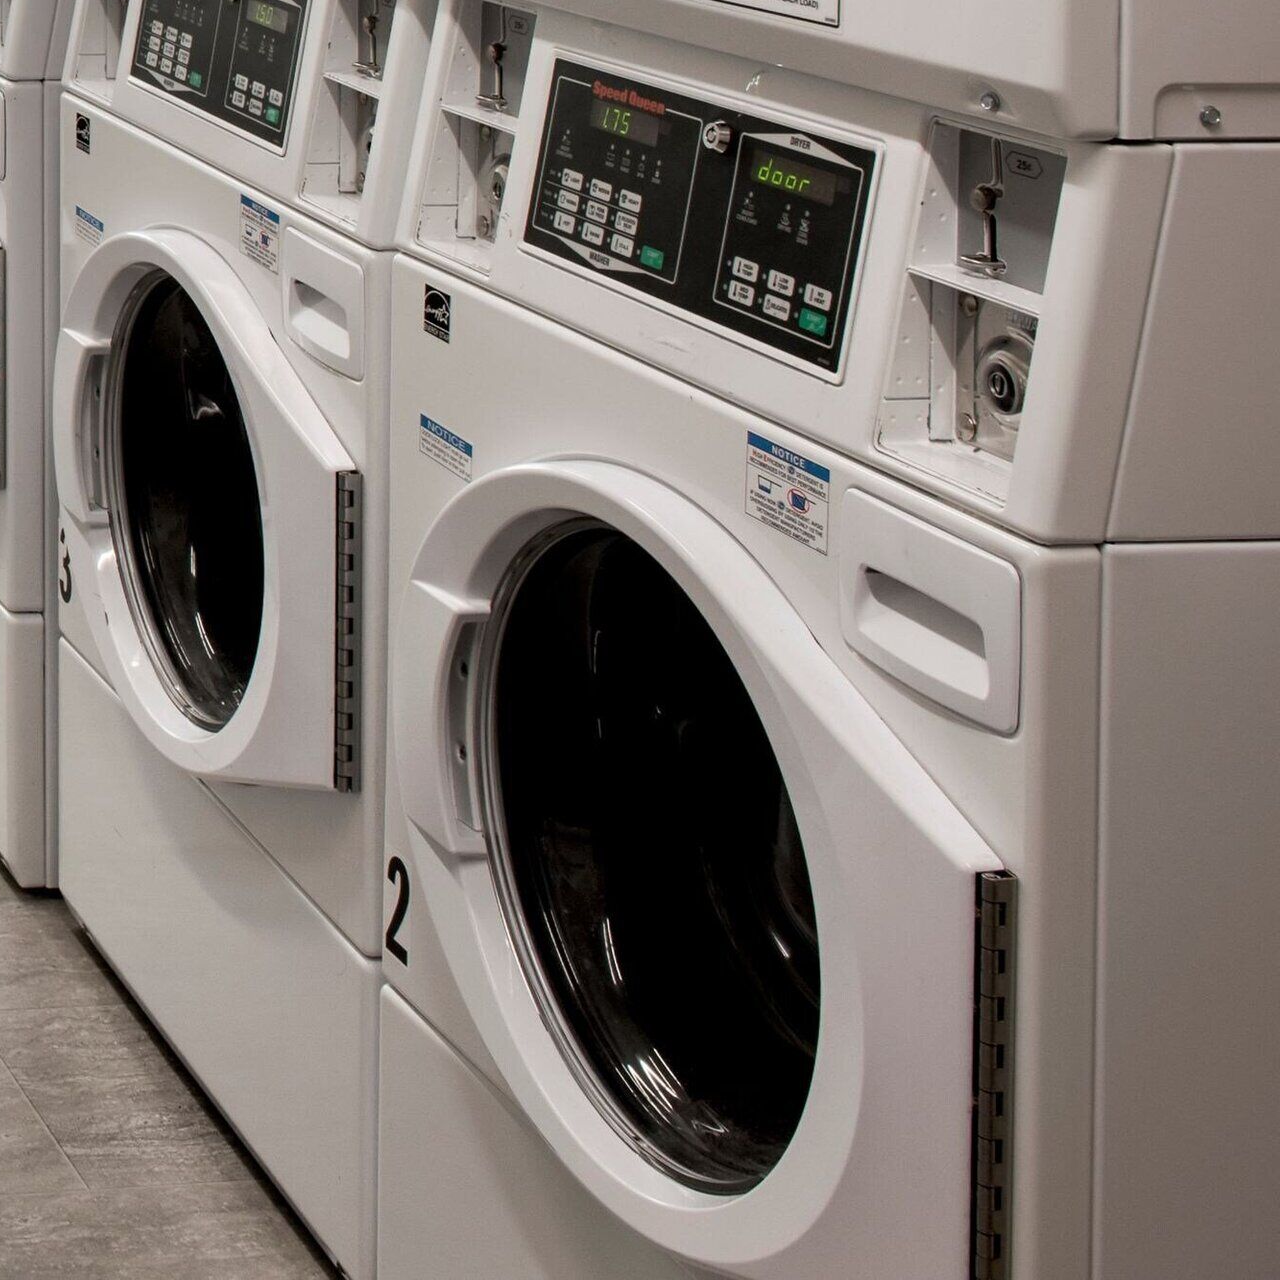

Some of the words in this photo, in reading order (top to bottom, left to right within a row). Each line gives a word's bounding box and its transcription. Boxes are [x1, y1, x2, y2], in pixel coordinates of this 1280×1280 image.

[592, 79, 628, 103] Speed
[628, 88, 666, 116] Queen
[602, 106, 631, 135] 1.75
[789, 136, 811, 150] DRYER
[758, 158, 811, 192] door
[588, 250, 610, 267] WASHER
[427, 419, 467, 452] NOTICE
[771, 445, 806, 469] NOTICE
[59, 527, 72, 604] 3
[385, 855, 410, 968] 2
